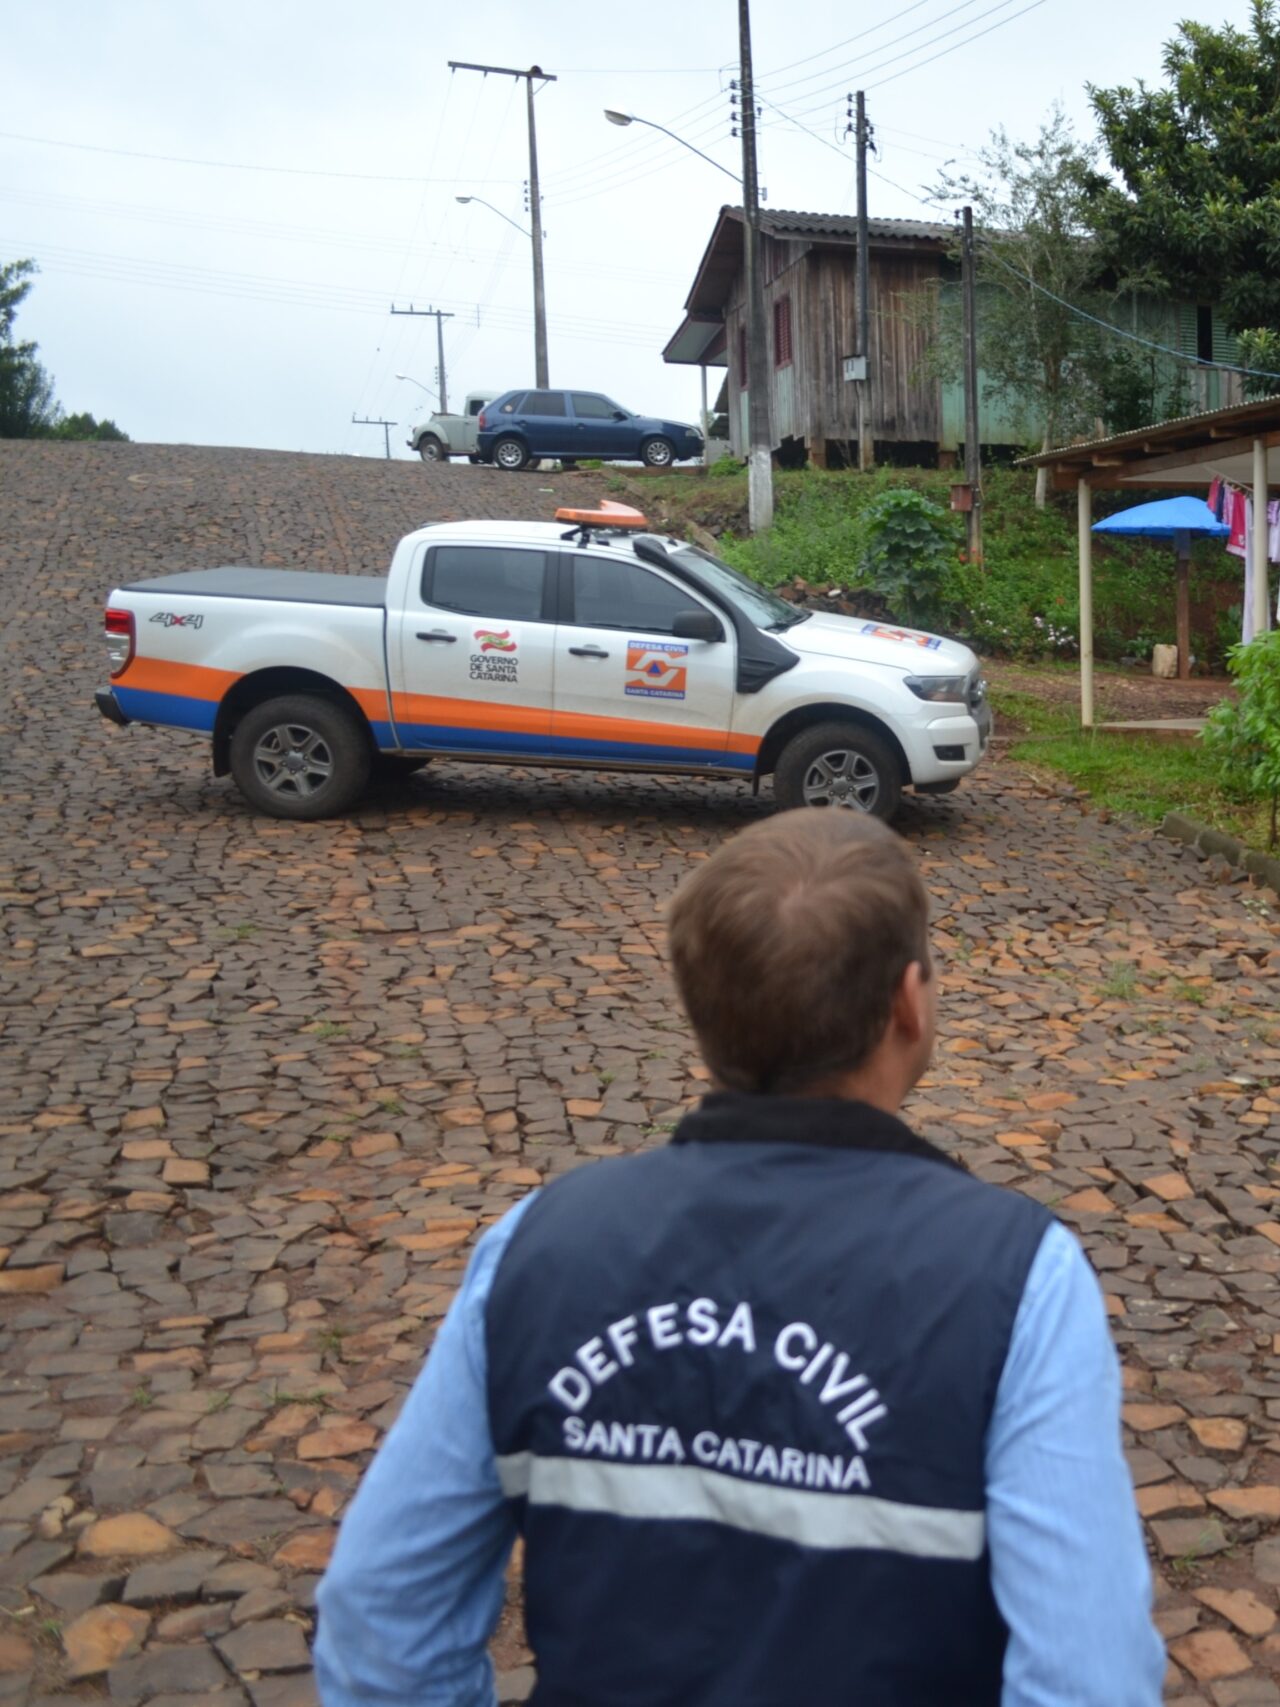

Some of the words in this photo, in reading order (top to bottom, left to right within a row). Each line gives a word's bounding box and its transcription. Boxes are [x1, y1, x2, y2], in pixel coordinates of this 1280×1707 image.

[629, 641, 662, 651] DEFESA
[664, 645, 686, 653] CIVIL
[470, 655, 518, 666] GOVERNO
[470, 663, 483, 671] DE
[486, 664, 517, 674] SANTA
[469, 671, 518, 683] CATARINA
[548, 1297, 755, 1412] DEFESA
[774, 1322, 889, 1452] CIVIL
[562, 1416, 684, 1460] SANTA
[692, 1430, 871, 1490] CATARINA
